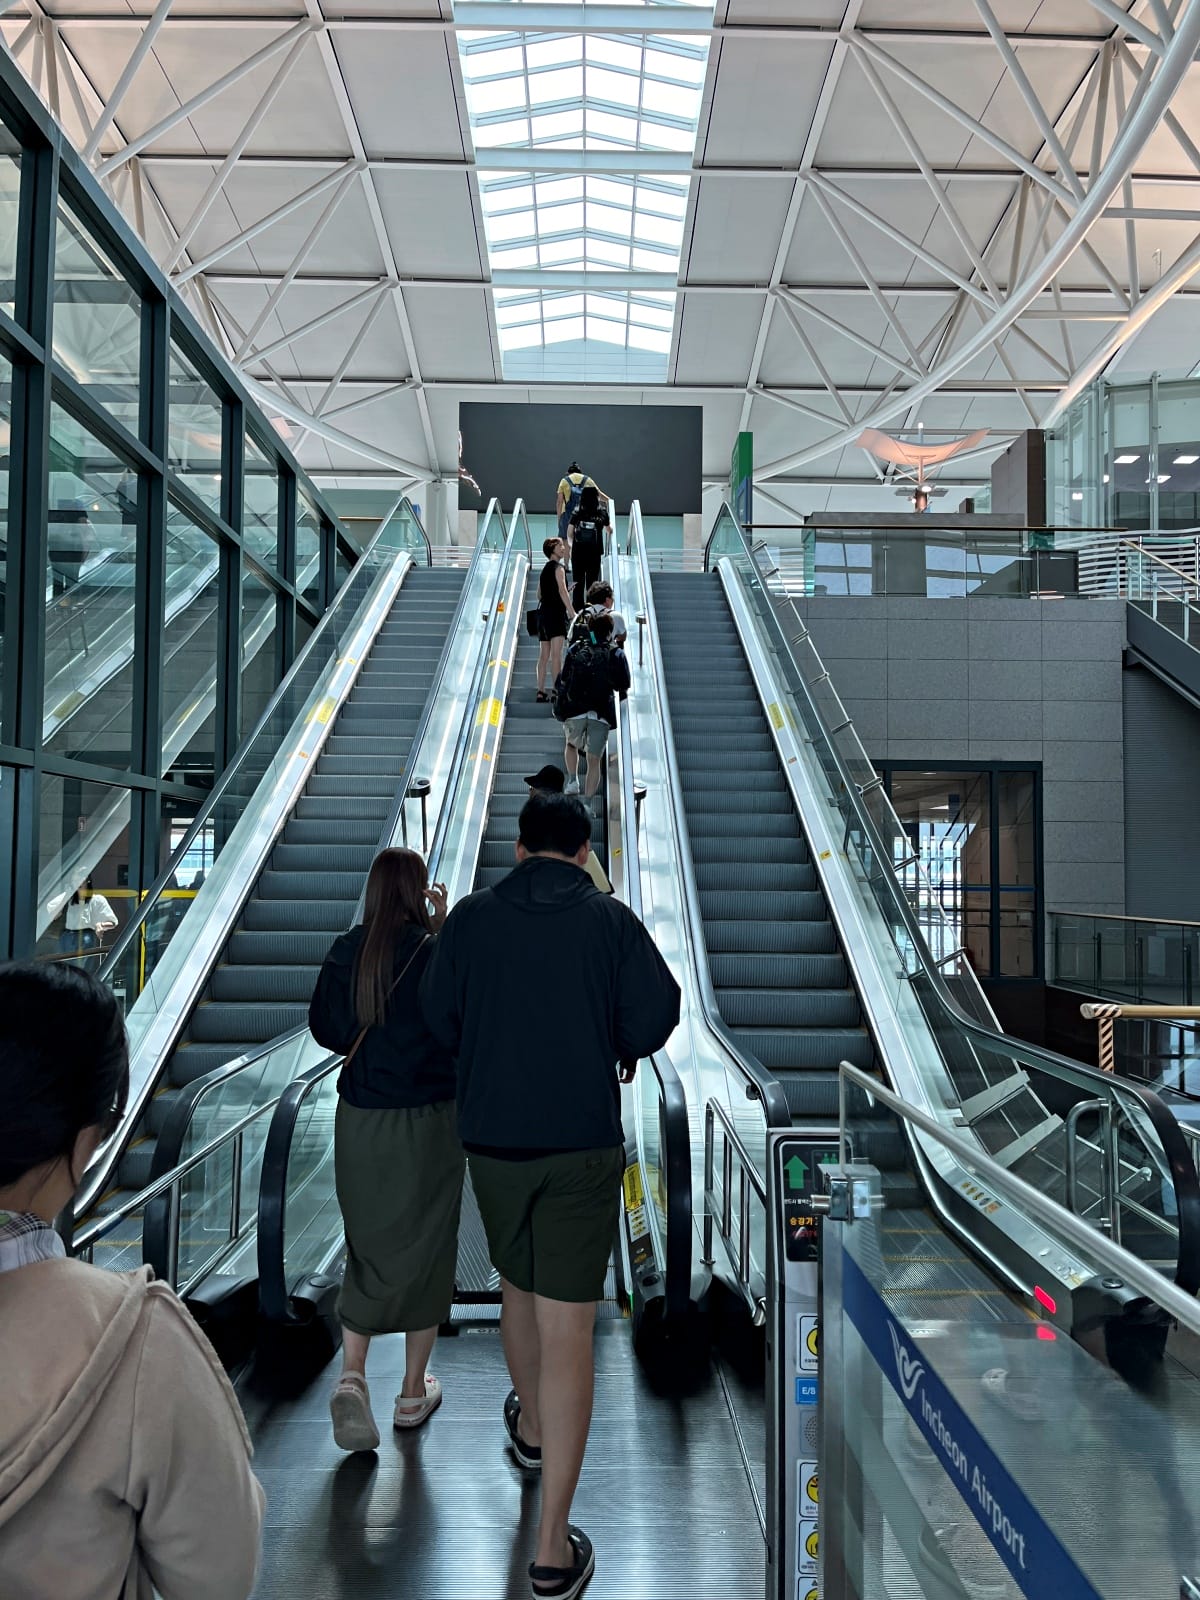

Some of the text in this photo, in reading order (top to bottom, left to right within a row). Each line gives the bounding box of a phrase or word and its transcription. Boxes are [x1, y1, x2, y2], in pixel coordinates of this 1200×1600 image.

[790, 1216, 812, 1226] 승강기
[802, 1386, 816, 1395] E/S
[921, 1388, 1026, 1569] Incheon Airport
